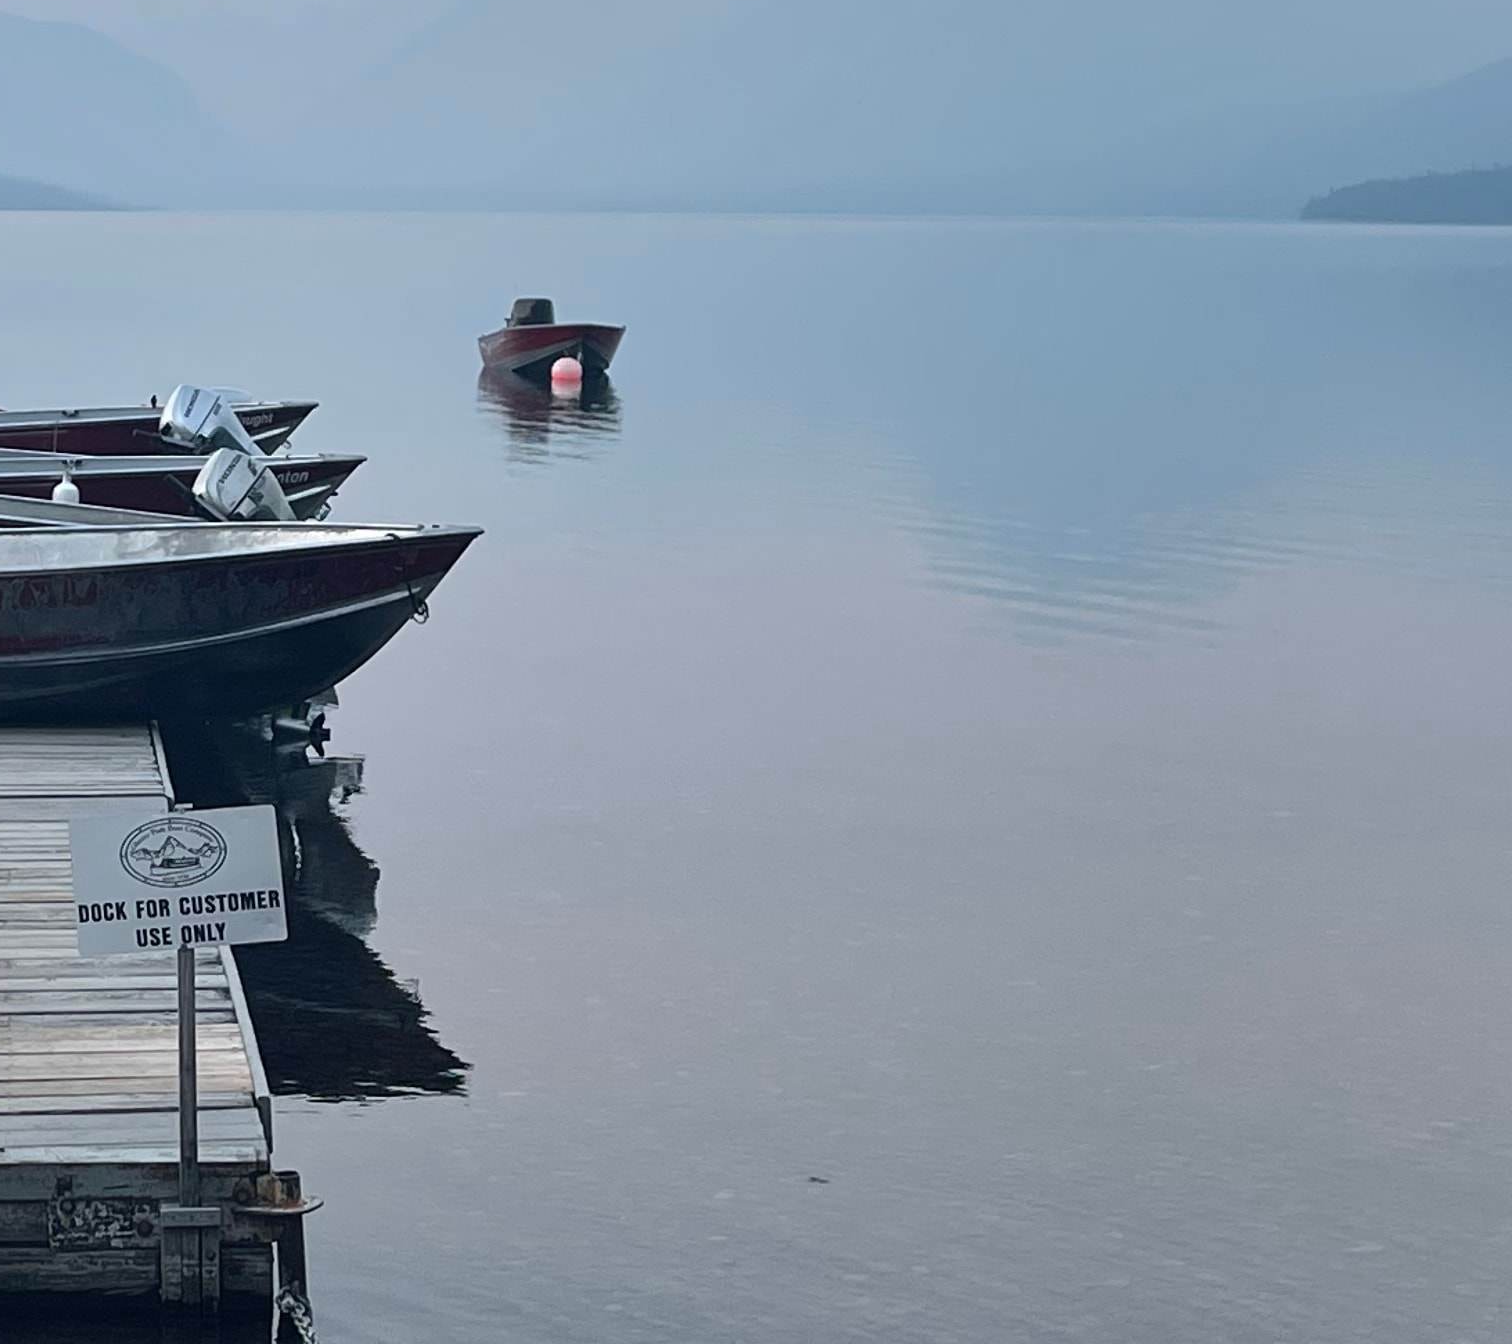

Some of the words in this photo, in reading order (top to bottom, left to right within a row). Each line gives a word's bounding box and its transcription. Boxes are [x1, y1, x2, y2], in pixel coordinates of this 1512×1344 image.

[78, 901, 128, 924] DOCK
[135, 898, 171, 919] FOR
[179, 889, 281, 915] CUSTOMER
[136, 926, 173, 948] USE
[180, 921, 226, 945] ONLY
